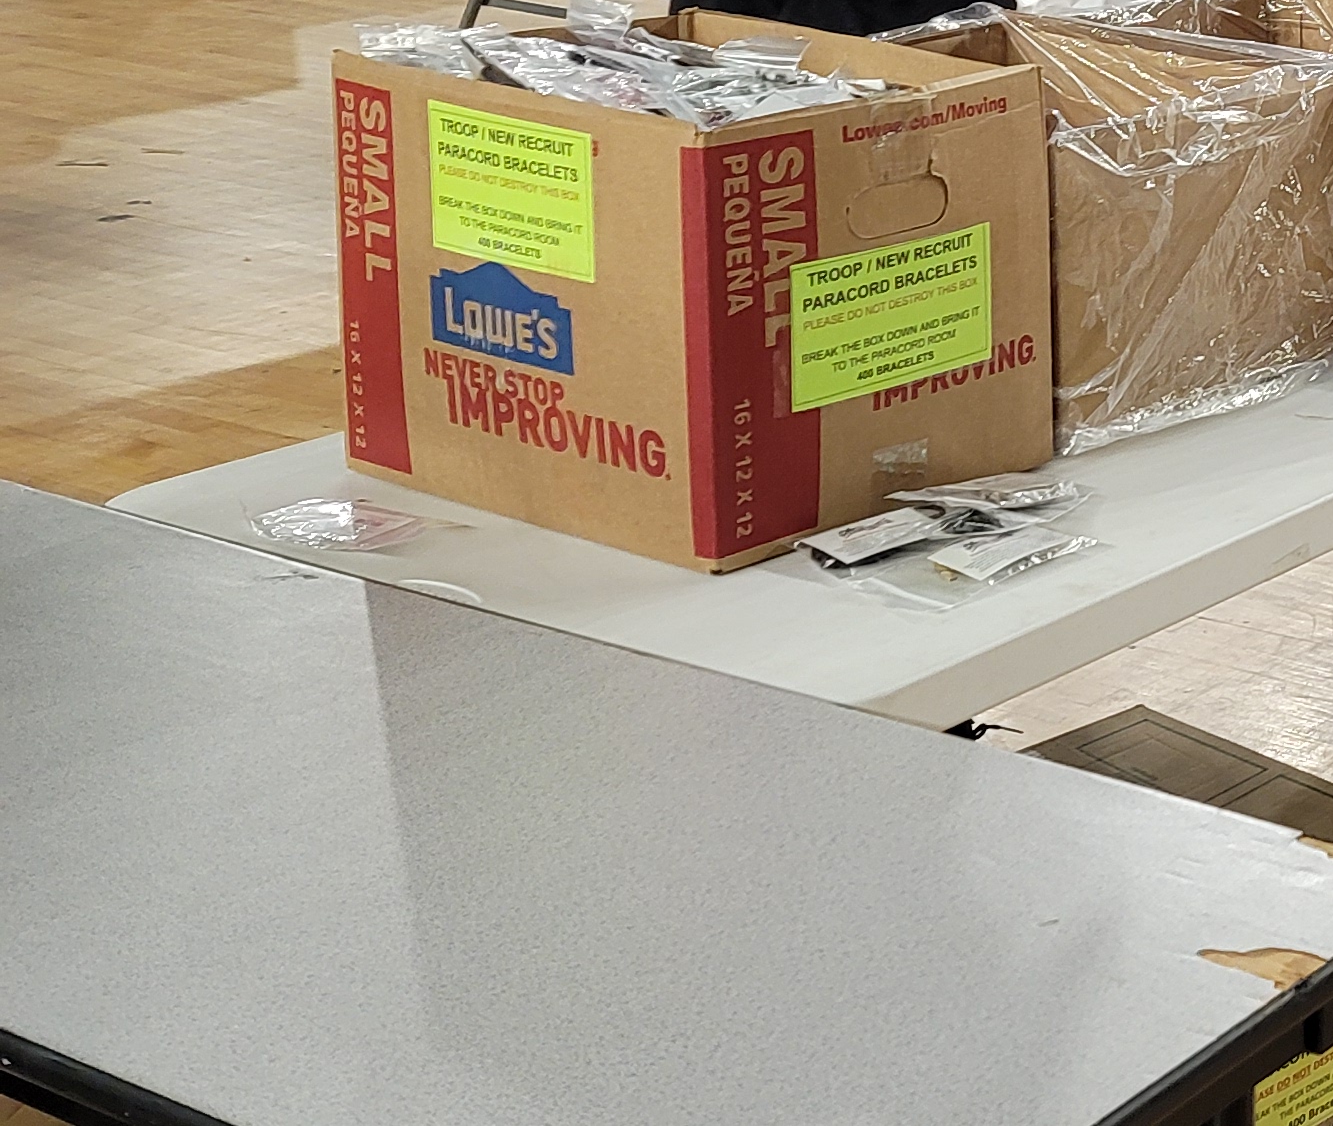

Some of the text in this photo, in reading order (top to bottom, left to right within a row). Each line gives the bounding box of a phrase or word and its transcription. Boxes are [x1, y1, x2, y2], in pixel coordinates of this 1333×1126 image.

[338, 90, 362, 238] PEQUEÑA
[437, 141, 579, 183] PARACORD BRACELETS
[439, 117, 480, 143] TROOP
[488, 127, 516, 148] NEW
[518, 134, 575, 158] RECRUIT
[358, 98, 393, 282] SMALL
[721, 153, 763, 318] PEQUEÑA
[757, 145, 806, 348] SMALL
[806, 261, 863, 288] TROOP
[875, 251, 910, 272] NEW
[913, 232, 974, 262] RECRUIT
[802, 255, 979, 314] PARACORD BRACELETS
[803, 276, 979, 332] PLEASE DO NOT DESTROY THIS BOX
[444, 286, 560, 360] LOWE'S
[801, 304, 982, 365] BREAK THE BOX DOWN AND BRING IT
[831, 328, 957, 373] TO THE PARACORD ROOM
[423, 347, 566, 408] NEVER STOP
[875, 350, 935, 376] BRACELETS
[733, 398, 752, 426] 16
[735, 455, 753, 483] 12
[736, 511, 754, 540] 12
[1276, 1077, 1292, 1092] DO
[1305, 1075, 1331, 1093] DOWN
